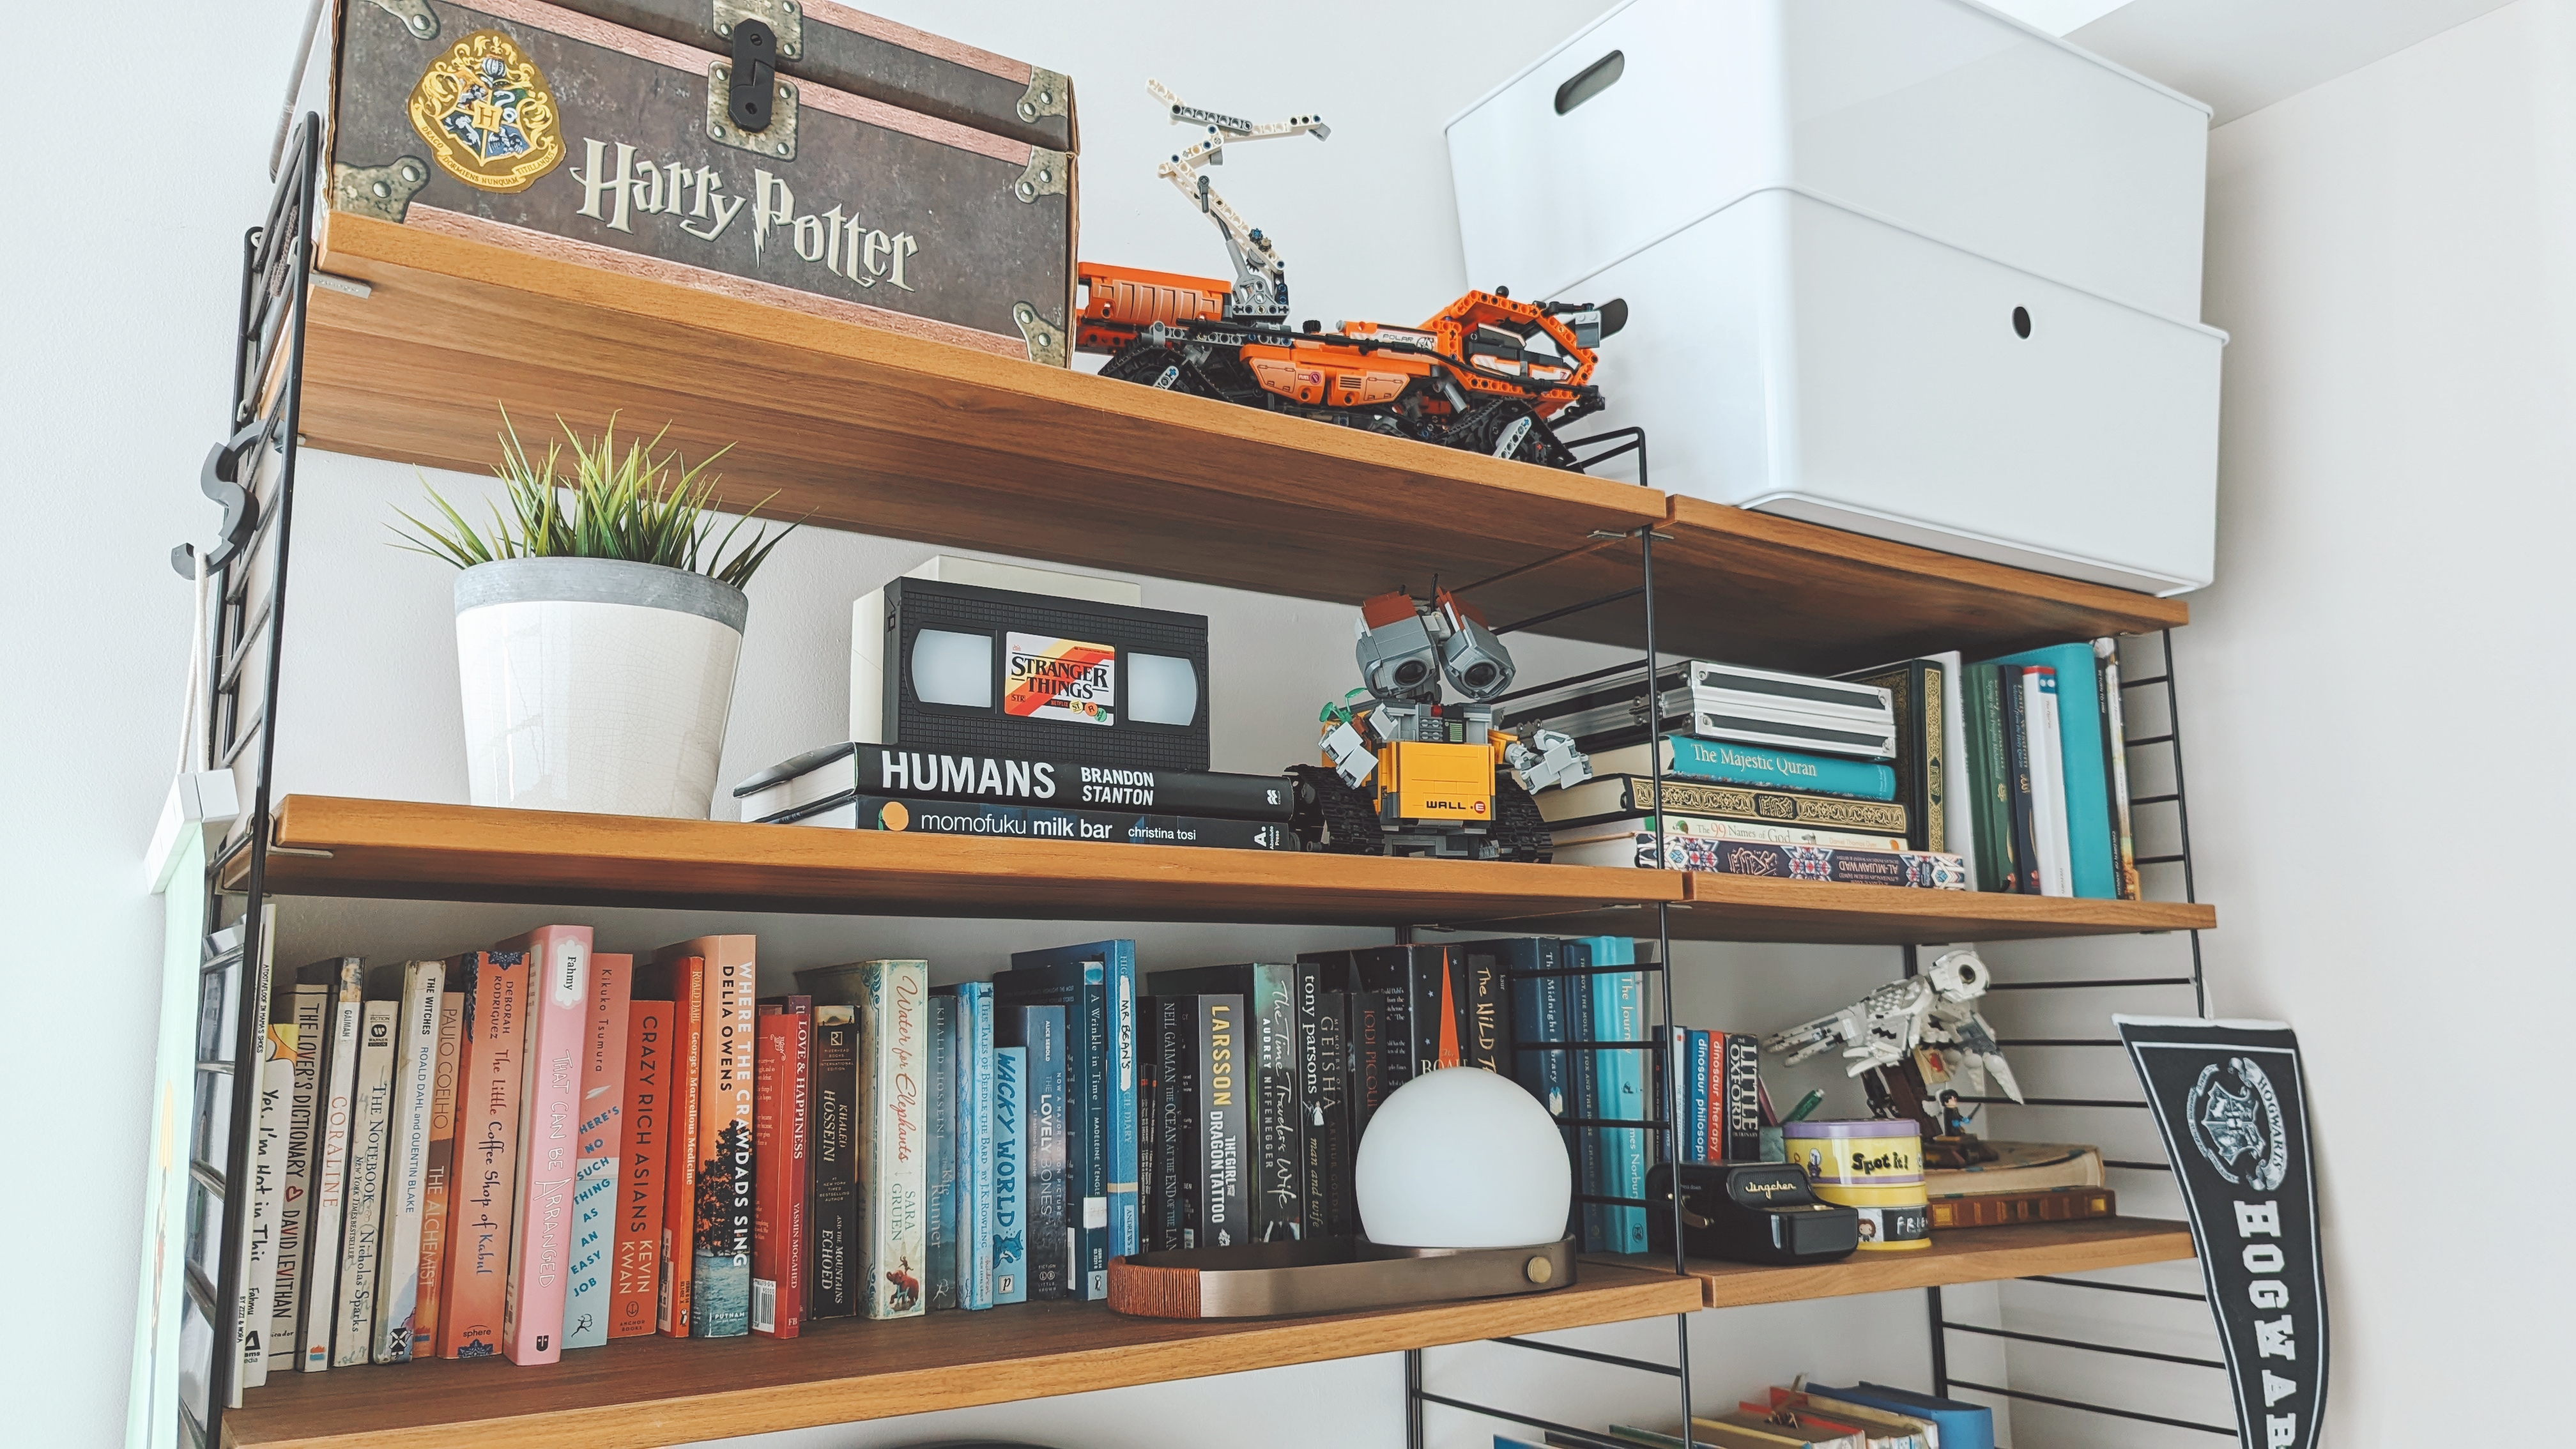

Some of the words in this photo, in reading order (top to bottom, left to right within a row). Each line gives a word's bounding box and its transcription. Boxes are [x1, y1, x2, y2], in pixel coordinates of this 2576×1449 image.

[443, 155, 479, 182] DORMIENS
[482, 177, 519, 186] NUNQUAM
[516, 151, 554, 174] TITILLANDUS
[569, 137, 746, 242] Harry
[753, 169, 919, 293] Potter
[1383, 334, 1413, 342] POLAR
[1011, 656, 1108, 687] STRANGER
[1027, 677, 1092, 699] THINGS
[881, 750, 1056, 799] HUMANS
[1081, 767, 1154, 788] BRANDON
[1690, 744, 1717, 763] The
[1721, 748, 1773, 772] Majestic
[1777, 757, 1817, 777] Quran
[1082, 785, 1154, 806] STANTON
[921, 811, 1027, 835] momofuku
[1033, 817, 1075, 838] milk
[1080, 819, 1113, 839] bar
[1128, 825, 1175, 840] christina
[1177, 828, 1197, 841] tosi
[1696, 824, 1710, 834] The
[1711, 823, 1726, 838] 99
[1728, 826, 1756, 839] Names
[1759, 829, 1765, 839] of
[1768, 829, 1790, 844] God
[426, 977, 436, 993] THE
[564, 956, 576, 990] Fahmy
[599, 969, 612, 1011] Kikuko
[722, 966, 734, 1018] DELIA
[1477, 967, 1491, 997] The
[299, 1003, 319, 1030] THE
[422, 996, 434, 1035] WITCHES
[489, 976, 502, 1039] RODRIGUEZ
[502, 981, 514, 1034] DEBORAH
[738, 962, 753, 1033] WHERE
[896, 976, 918, 1046] Water
[981, 1001, 990, 1023] THE
[1091, 994, 1100, 1003] A
[1121, 1000, 1129, 1021] MR
[1272, 980, 1290, 1025] The
[1302, 975, 1315, 1017] tony
[257, 1013, 266, 1034] MAMA'S
[342, 1009, 353, 1037] GAIMAN
[440, 1009, 457, 1056] PAULO
[797, 1020, 807, 1060] LOVE
[981, 1024, 991, 1054] TALES
[1091, 1008, 1101, 1051] Wrinkle
[1262, 1018, 1271, 1069] AUDREY
[295, 1035, 316, 1090] LOVER'S
[418, 1047, 429, 1081] ROALD
[493, 1049, 510, 1073] The
[595, 1019, 609, 1072] Tsumura
[640, 1016, 658, 1086] CRAZY
[689, 1032, 700, 1074] George's
[721, 1025, 733, 1091] OWENS
[737, 1041, 751, 1080] THE
[891, 1048, 913, 1069] for
[981, 1057, 990, 1070] OF
[1091, 1056, 1100, 1067] in
[1121, 1025, 1131, 1070] BEAN'S
[1212, 1006, 1232, 1105] LARSSON
[1275, 1018, 1290, 1077] Time
[1302, 1023, 1317, 1094] parsons
[1321, 1016, 1335, 1110] GEISHA
[1698, 1039, 1707, 1094] dinosaur
[552, 1049, 573, 1094] THAT
[797, 1062, 806, 1075] &
[1092, 1071, 1101, 1100] Time
[1712, 1041, 1721, 1096] dinosaur
[1729, 1044, 1742, 1130] OXFORD
[1740, 1045, 1758, 1131] LITTLE
[370, 1083, 388, 1115] THE
[415, 1084, 425, 1112] DAHL
[433, 1062, 454, 1129] COELHO
[489, 1080, 507, 1115] Little
[688, 1077, 698, 1135] Marvellous
[981, 1073, 990, 1111] BEEDLE
[997, 1052, 1016, 1133] WACKY
[1275, 1072, 1293, 1152] Traveler's
[286, 1094, 312, 1178] DICTIONARY
[413, 1114, 421, 1130] and
[549, 1101, 569, 1139] CAN
[579, 1106, 620, 1135] HERE'S
[636, 1094, 654, 1144] RICH
[794, 1077, 806, 1159] HAPPINESS
[823, 1089, 836, 1162] HOSSEINI
[839, 1104, 848, 1148] KHALED
[889, 1073, 917, 1163] Elephants
[1041, 1094, 1052, 1153] LOVELY
[1264, 1077, 1273, 1169] NIFFENEGGER
[1695, 1099, 1706, 1161] philosoph
[1710, 1101, 1721, 1152] therapy
[2257, 1076, 2283, 1170] HOGWARTS
[323, 1096, 348, 1208] CORALINE
[364, 1119, 384, 1203] NOTEBOOK
[409, 1132, 420, 1177] QUENTIN
[478, 1121, 505, 1165] Coffee
[548, 1147, 564, 1171] BE
[585, 1138, 604, 1153] NO
[686, 1137, 696, 1185] Medicine
[734, 1089, 750, 1208] CRAWDADS
[981, 1137, 990, 1164] BARD
[1209, 1110, 1224, 1170] DRAGON
[355, 1157, 364, 1174] NEW
[427, 1165, 445, 1195] THE
[577, 1156, 610, 1181] SUCH
[981, 1170, 987, 1181] BY
[996, 1138, 1015, 1227] WORLD
[1266, 1158, 1297, 1209] Wife
[1851, 1153, 1890, 1175] Spot
[1892, 1151, 1908, 1170] it!
[353, 1176, 362, 1195] YORK
[406, 1180, 416, 1213] BLAKE
[470, 1170, 501, 1208] Shop
[574, 1178, 611, 1205] THING
[631, 1153, 650, 1232] ASIANS
[1040, 1158, 1053, 1215] BONES
[1209, 1170, 1225, 1223] TATTOO
[279, 1210, 301, 1250] DAVID
[350, 1198, 360, 1220] TIMES
[471, 1214, 498, 1229] of
[583, 1208, 599, 1223] AS
[891, 1183, 902, 1241] GRUEN
[905, 1191, 916, 1230] SARA
[347, 1220, 356, 1260] BESTSELLER
[419, 1200, 441, 1287] ALCHEMIST
[533, 1177, 572, 1288] ARRANGED
[581, 1231, 599, 1247] AN
[733, 1216, 747, 1267] SING
[355, 1229, 374, 1285] Nicholas
[476, 1234, 494, 1275] Kabul
[571, 1250, 601, 1275] EASY
[619, 1241, 635, 1294] KWAN
[637, 1240, 653, 1292] KEVIN
[822, 1230, 833, 1289] ECHOED
[834, 1246, 843, 1304] MOUNTAINS
[272, 1254, 296, 1318] LEVITHAN
[574, 1278, 597, 1297] JOB
[346, 1289, 369, 1332] Sparks
